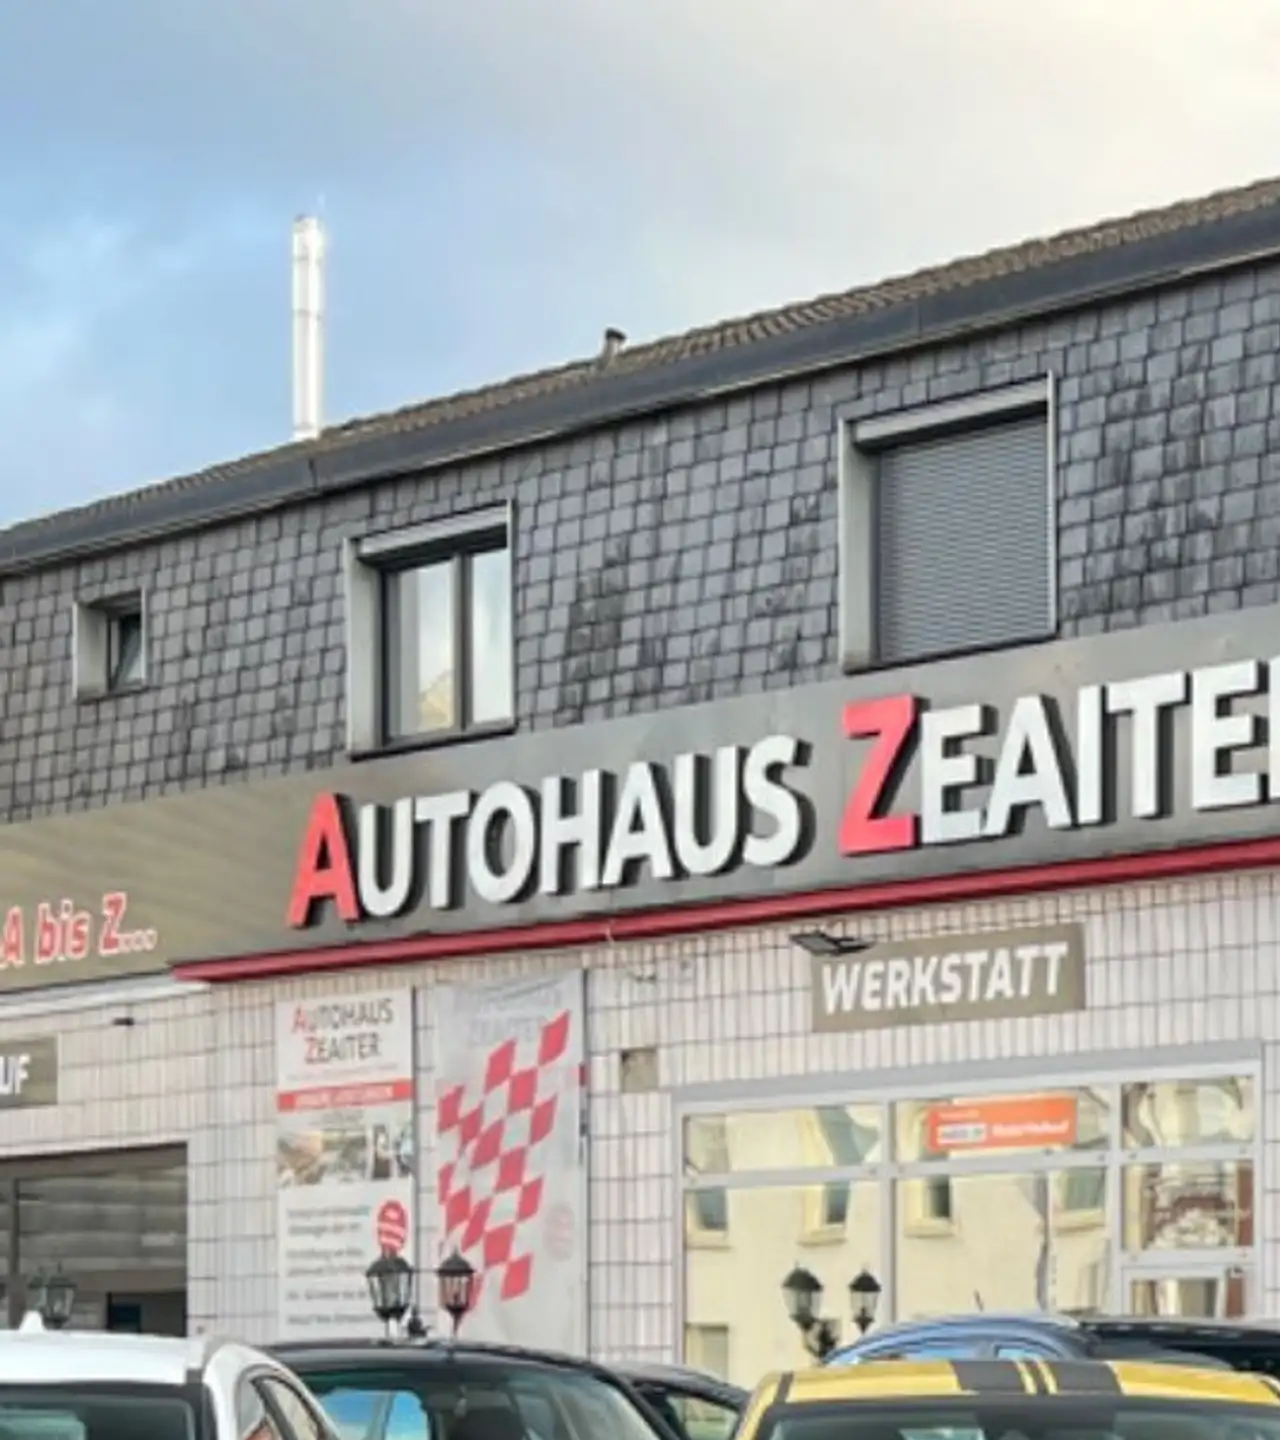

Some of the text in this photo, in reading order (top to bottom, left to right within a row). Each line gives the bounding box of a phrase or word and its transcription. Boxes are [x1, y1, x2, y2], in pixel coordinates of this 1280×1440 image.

[285, 734, 806, 928] AUTOHAUS
[35, 900, 91, 964] bis
[820, 942, 1067, 1014] WERKSTATT
[292, 998, 394, 1034] AUTOHAUS
[304, 1031, 380, 1065] ZEAITER
